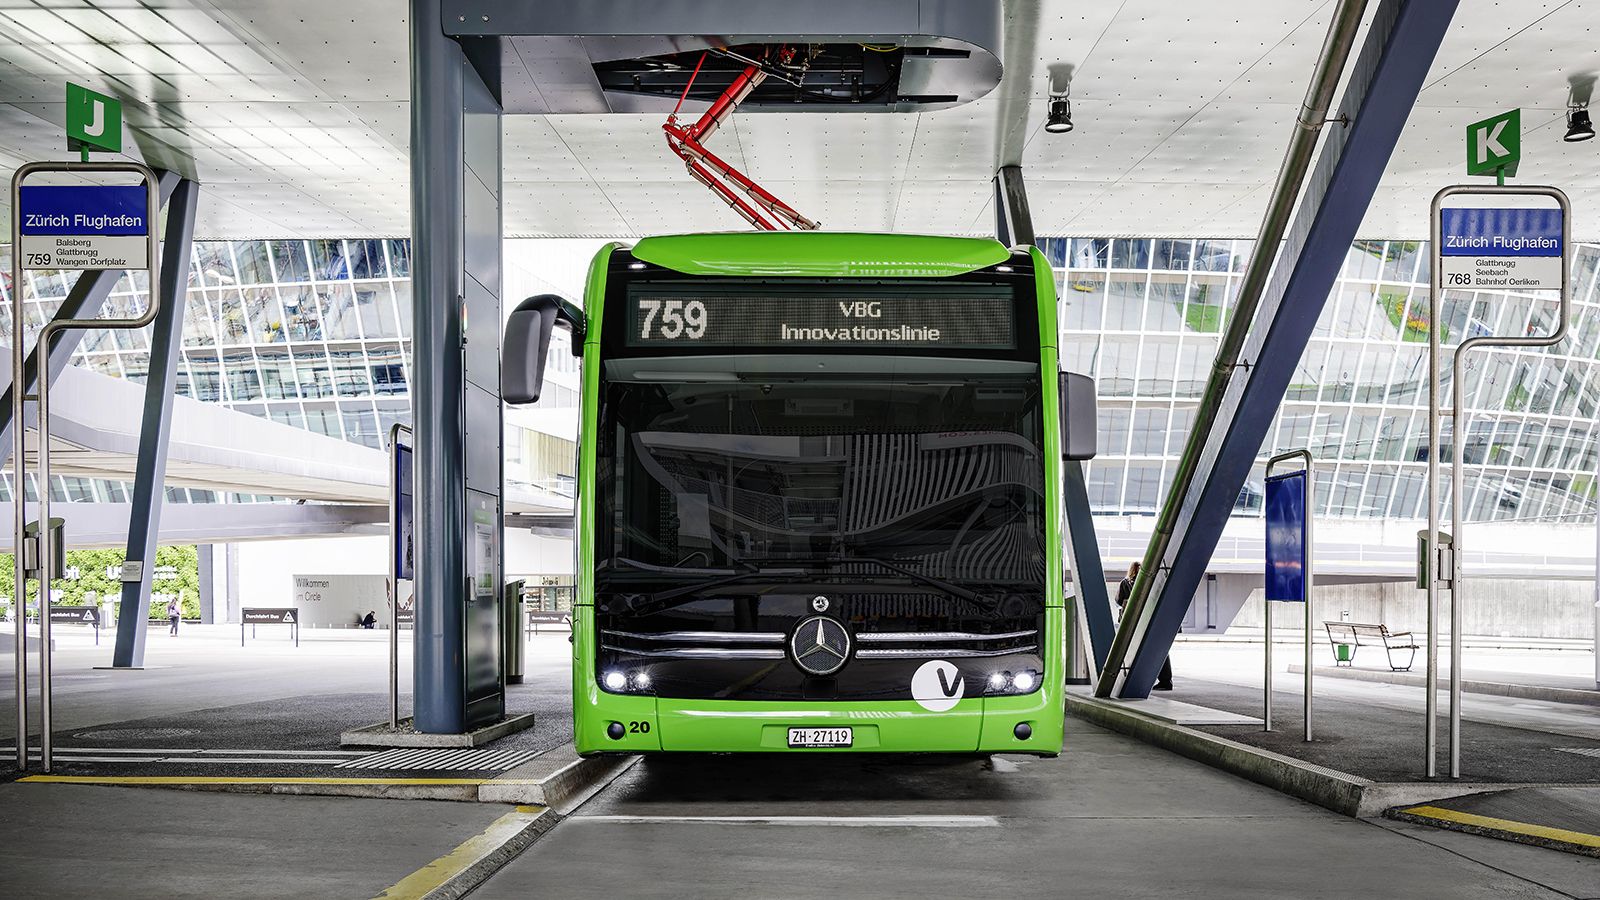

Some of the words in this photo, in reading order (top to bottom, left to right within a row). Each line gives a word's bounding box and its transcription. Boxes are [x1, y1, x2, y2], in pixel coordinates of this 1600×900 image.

[84, 99, 104, 136] J
[1476, 119, 1511, 164] K
[25, 213, 70, 227] Zürich
[74, 213, 142, 229] Flughafen
[56, 238, 92, 247] Balsberg
[1447, 234, 1489, 248] Zürich
[1493, 235, 1558, 251] Flughafen
[56, 248, 98, 257] Glattbrugg
[26, 253, 51, 265] 759
[56, 257, 89, 267] Wangen
[90, 257, 127, 267] Dorfplatz
[1475, 258, 1516, 268] Glattbrugg
[1475, 268, 1509, 276] Seebach
[1447, 273, 1471, 285] 768
[1475, 277, 1507, 286] Bahnhof
[1509, 277, 1540, 286] Oerlikon
[840, 301, 882, 318] VBG
[639, 300, 708, 339] 759
[781, 323, 941, 341] Innovationslinie
[295, 578, 330, 588] Willkommen
[629, 721, 650, 734] 20
